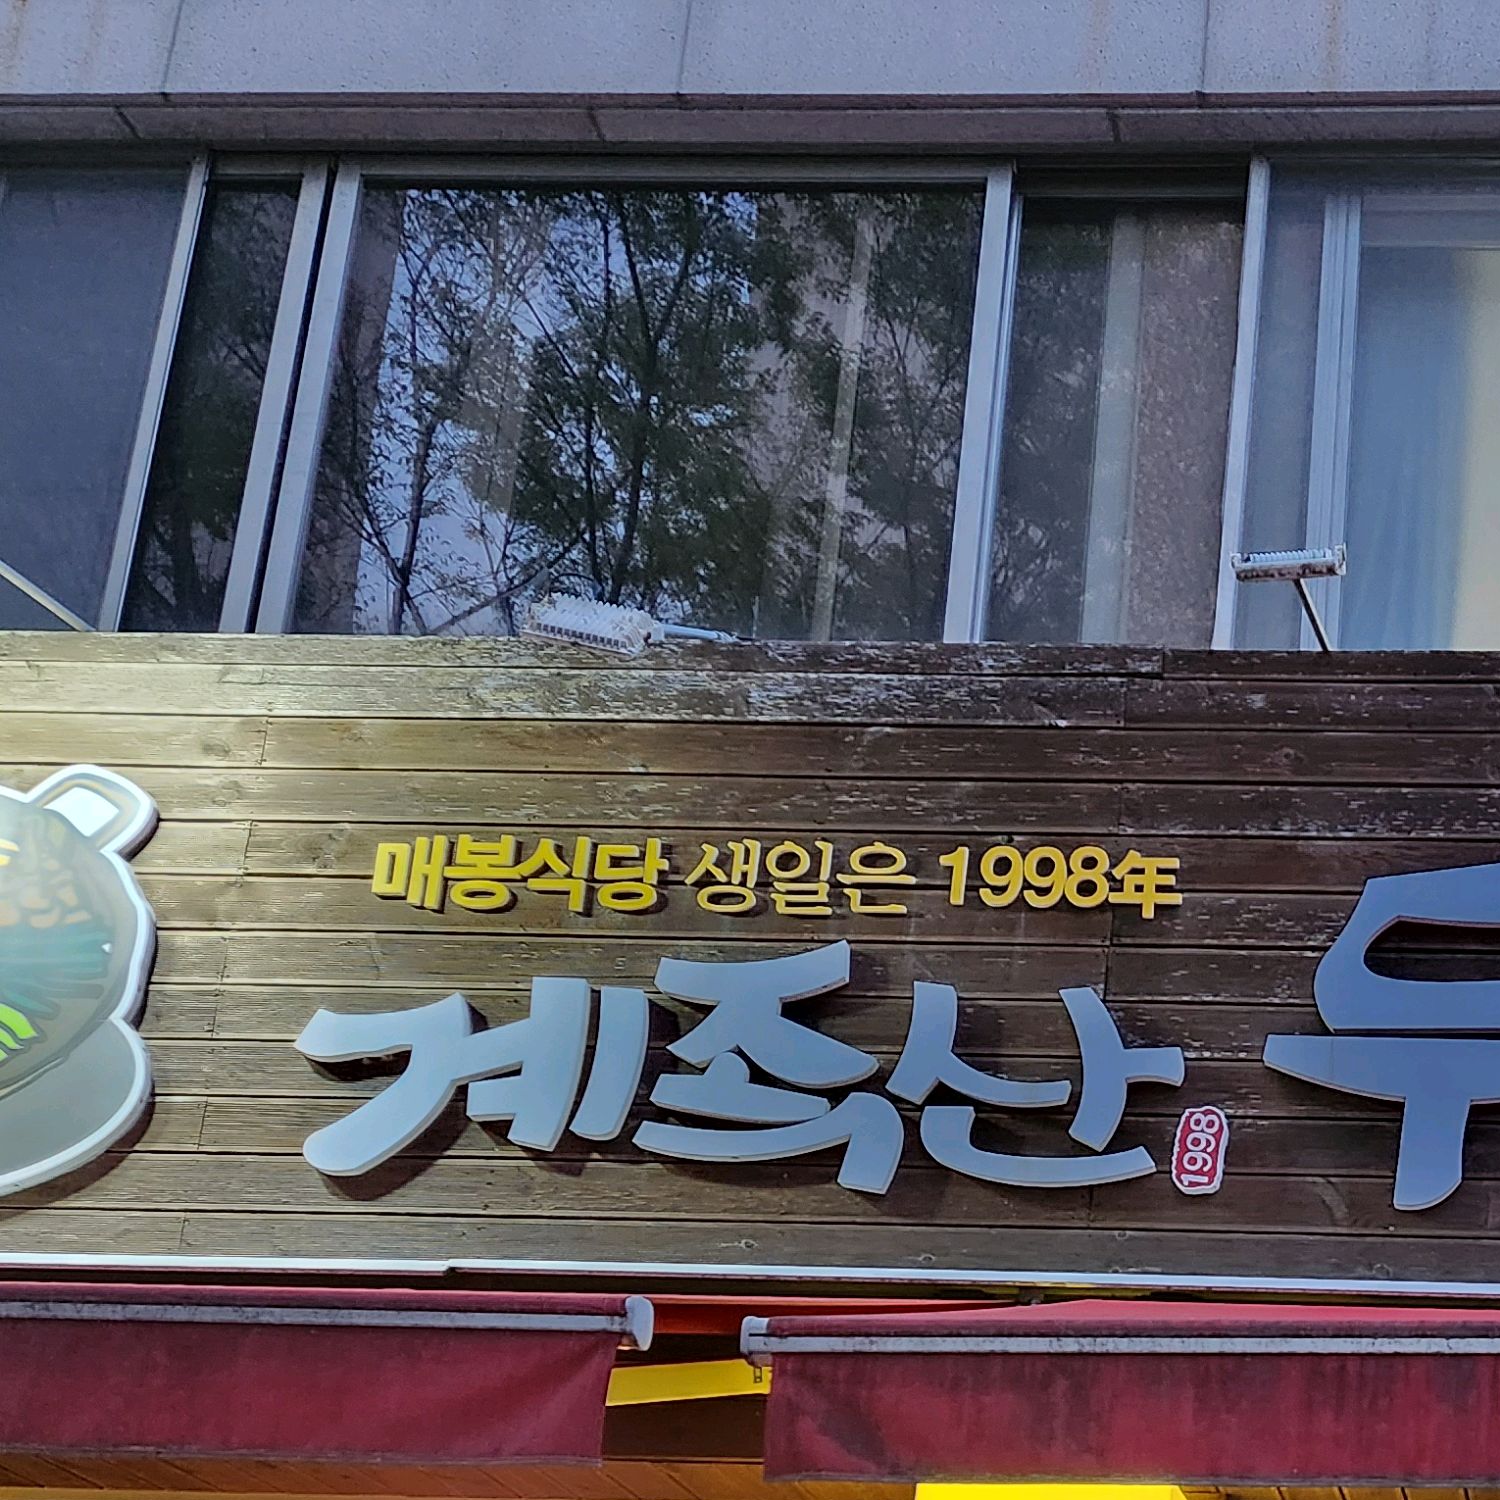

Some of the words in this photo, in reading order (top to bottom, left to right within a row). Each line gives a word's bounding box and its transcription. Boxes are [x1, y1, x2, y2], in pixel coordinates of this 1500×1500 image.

[371, 834, 669, 914] 매봉식당
[684, 840, 917, 919] 생일은
[939, 844, 1184, 920] 1998年
[293, 938, 1186, 1195] 계족산
[1178, 1108, 1224, 1192] 1998
